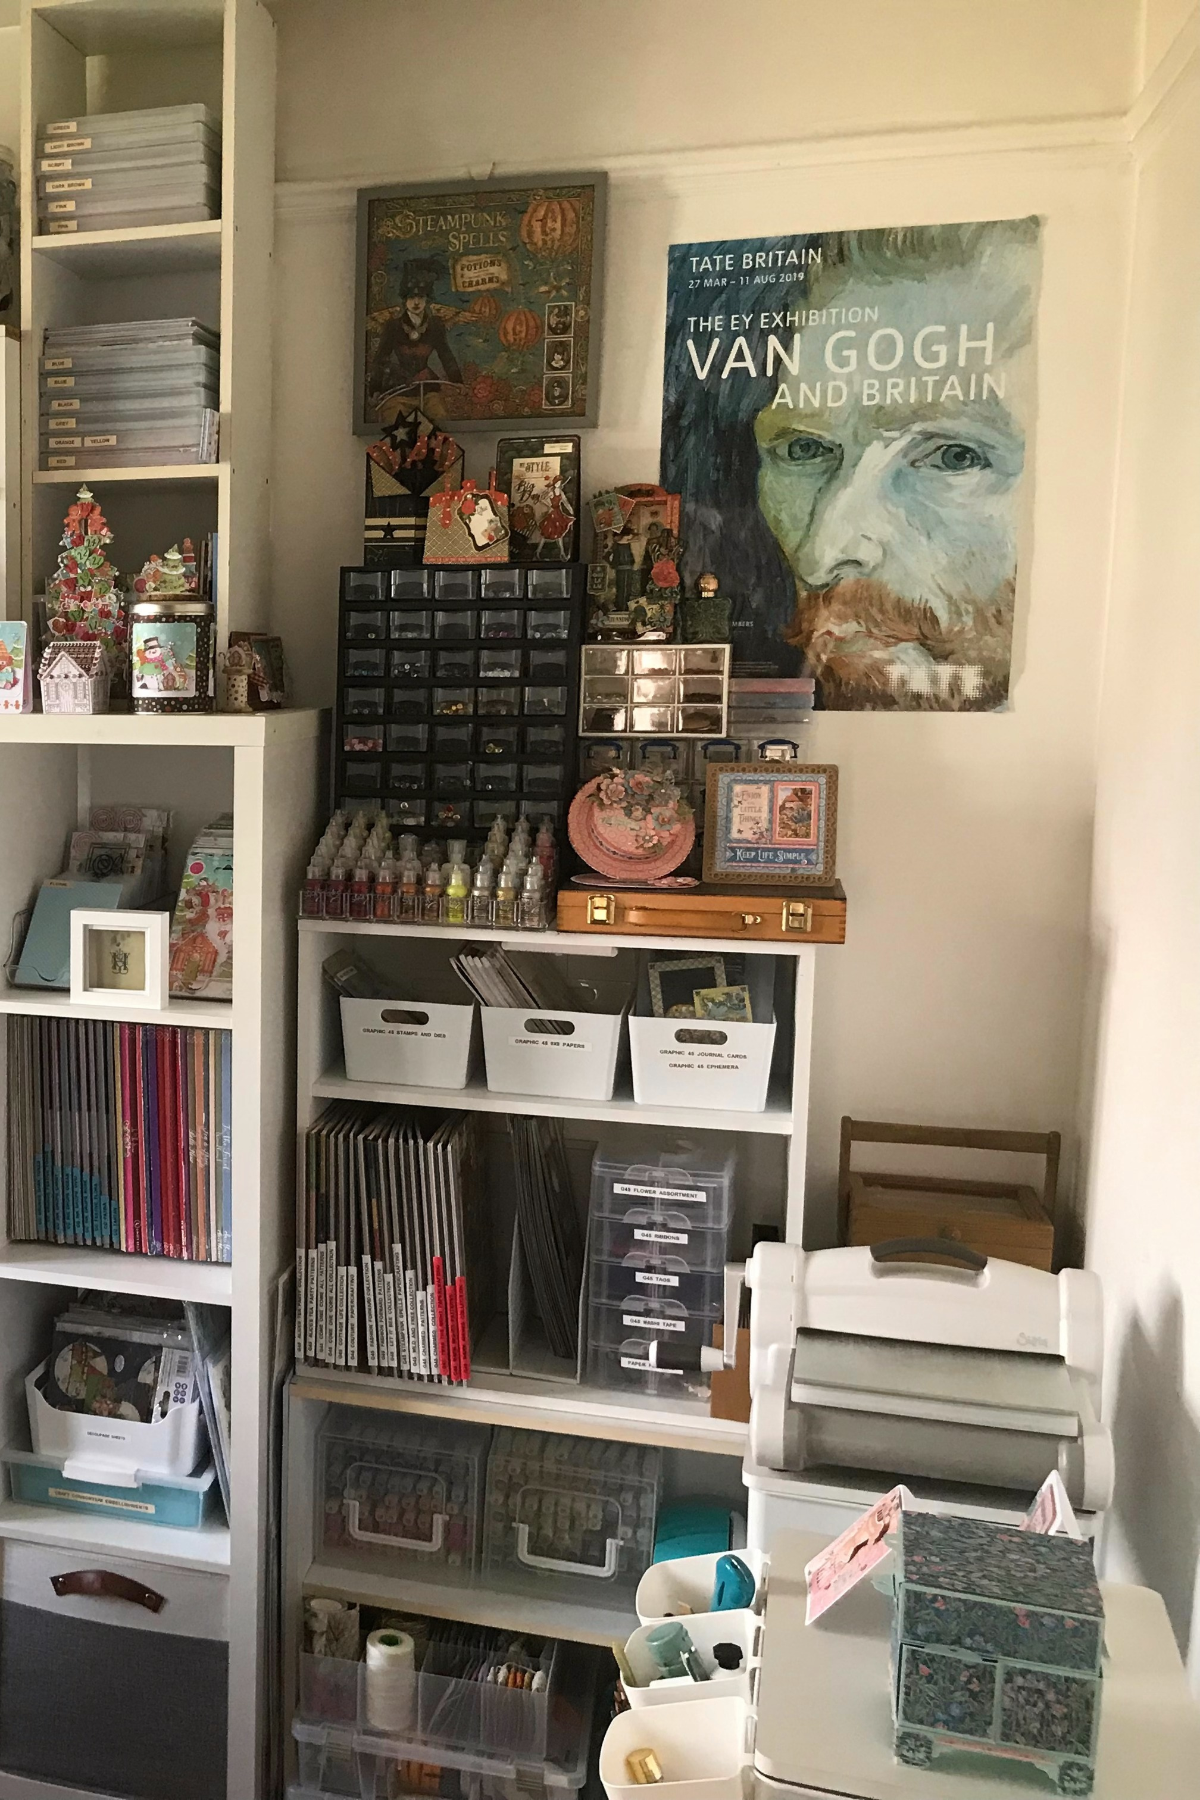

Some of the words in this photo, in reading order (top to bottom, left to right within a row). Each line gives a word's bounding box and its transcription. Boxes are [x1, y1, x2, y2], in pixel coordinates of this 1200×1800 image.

[390, 210, 507, 238] STEAMPUNK
[449, 231, 507, 252] SPELLS
[460, 260, 501, 271] POTIONS
[690, 254, 733, 274] TATE
[742, 248, 822, 269] BRITAIN
[462, 276, 499, 288] CHARMS
[688, 279, 700, 289] 27
[703, 277, 727, 288] MAR
[740, 276, 749, 285] 11
[753, 274, 776, 285] AUG
[779, 272, 805, 284] 2019
[688, 317, 723, 333] THE
[731, 314, 754, 330] EY
[761, 306, 878, 330] EXHIBITION
[687, 333, 800, 380] VAN
[825, 322, 994, 373] GOGH
[771, 382, 848, 410] AND
[863, 373, 1007, 406] BRITAIN
[525, 461, 551, 473] STYLE
[736, 848, 756, 860] KEEP
[758, 849, 774, 861] LIFE
[775, 850, 805, 862] SIMPLE
[659, 1190, 698, 1199] ASSORTMENT
